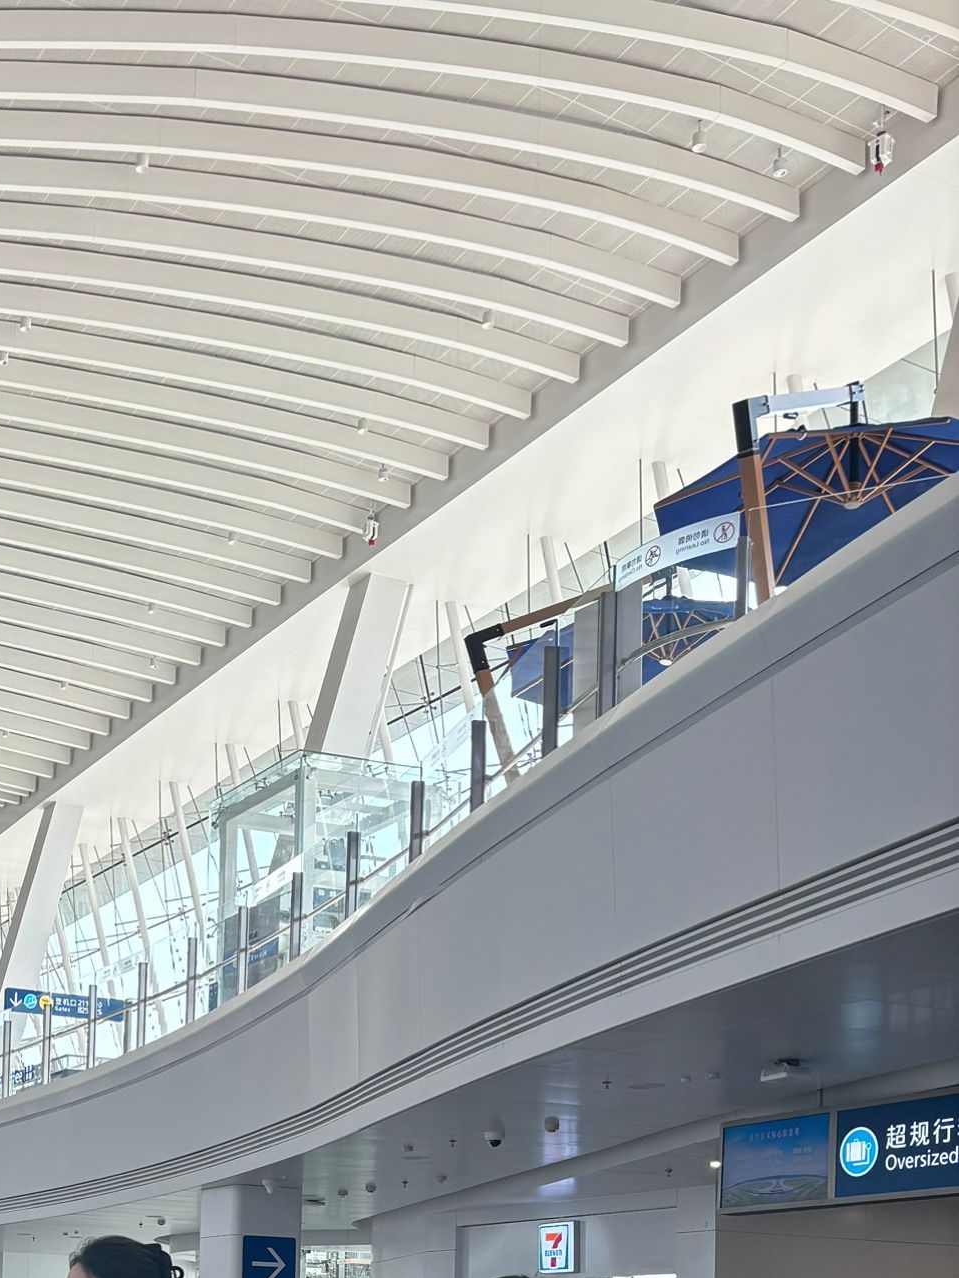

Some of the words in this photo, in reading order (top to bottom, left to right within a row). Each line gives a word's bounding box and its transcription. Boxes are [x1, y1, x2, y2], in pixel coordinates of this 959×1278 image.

[885, 1118, 959, 1150] 超规行
[885, 1145, 959, 1171] Oversized
